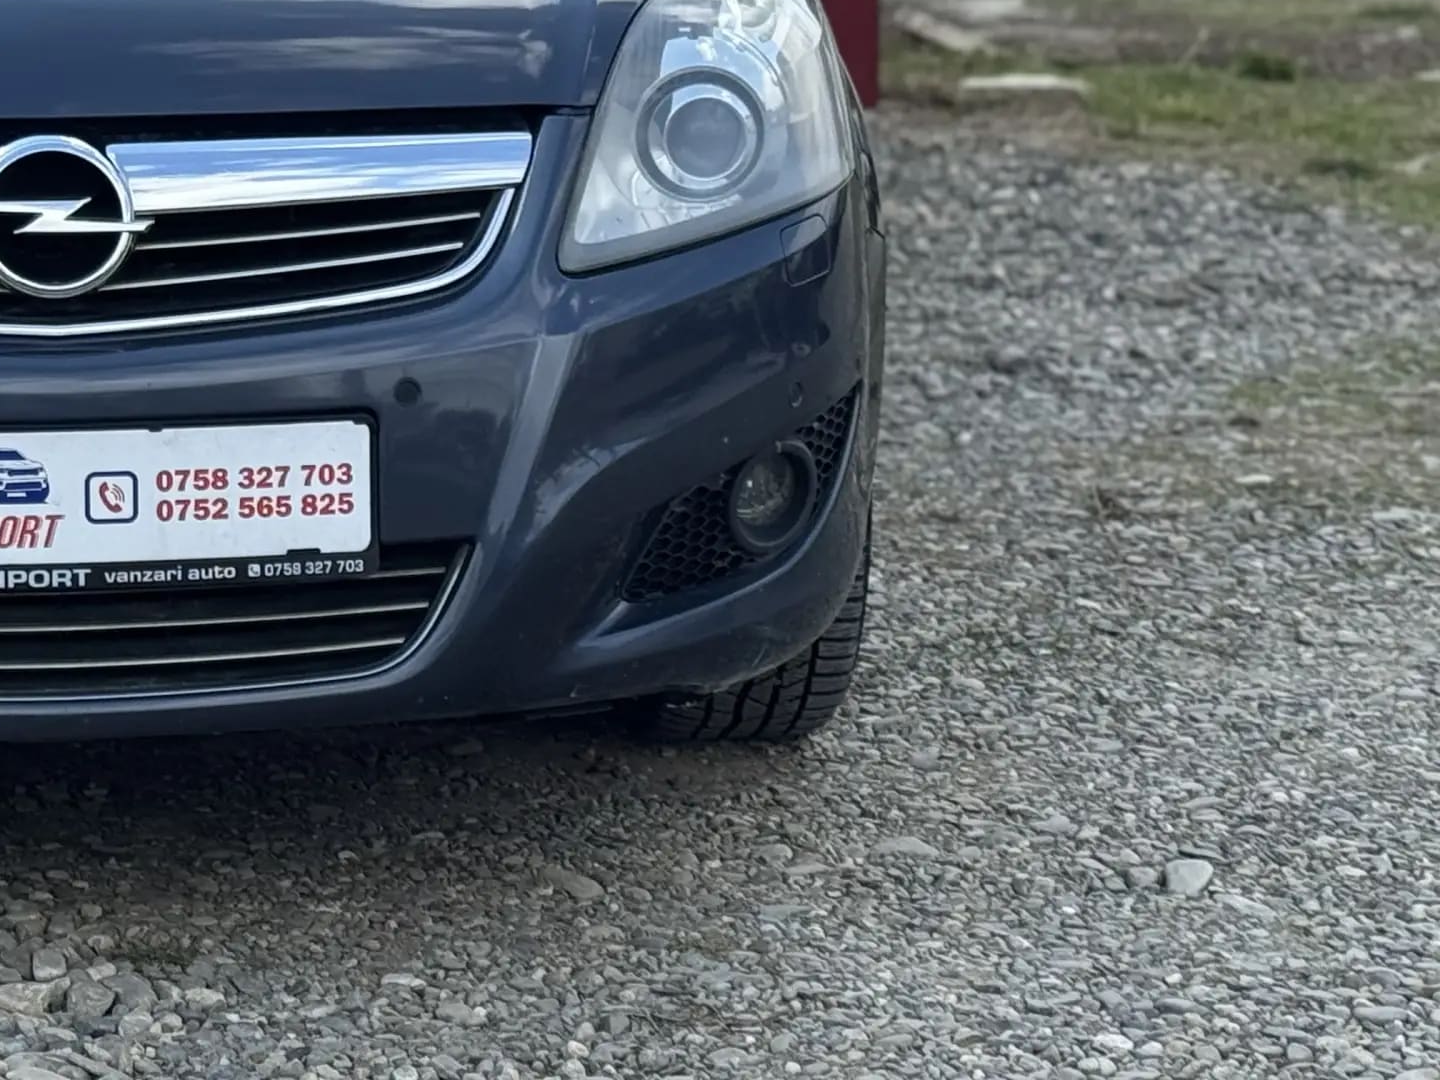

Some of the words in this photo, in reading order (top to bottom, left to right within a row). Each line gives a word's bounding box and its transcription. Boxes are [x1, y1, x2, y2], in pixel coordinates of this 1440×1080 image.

[155, 468, 229, 493] 0758
[237, 465, 291, 490] 327
[300, 462, 354, 487] 703
[155, 497, 230, 522] 0752
[237, 495, 293, 519] 565
[300, 492, 355, 516] 825
[104, 565, 183, 584] vanzari
[187, 565, 237, 581] auto
[305, 560, 333, 575] 327
[337, 558, 365, 573] 703
